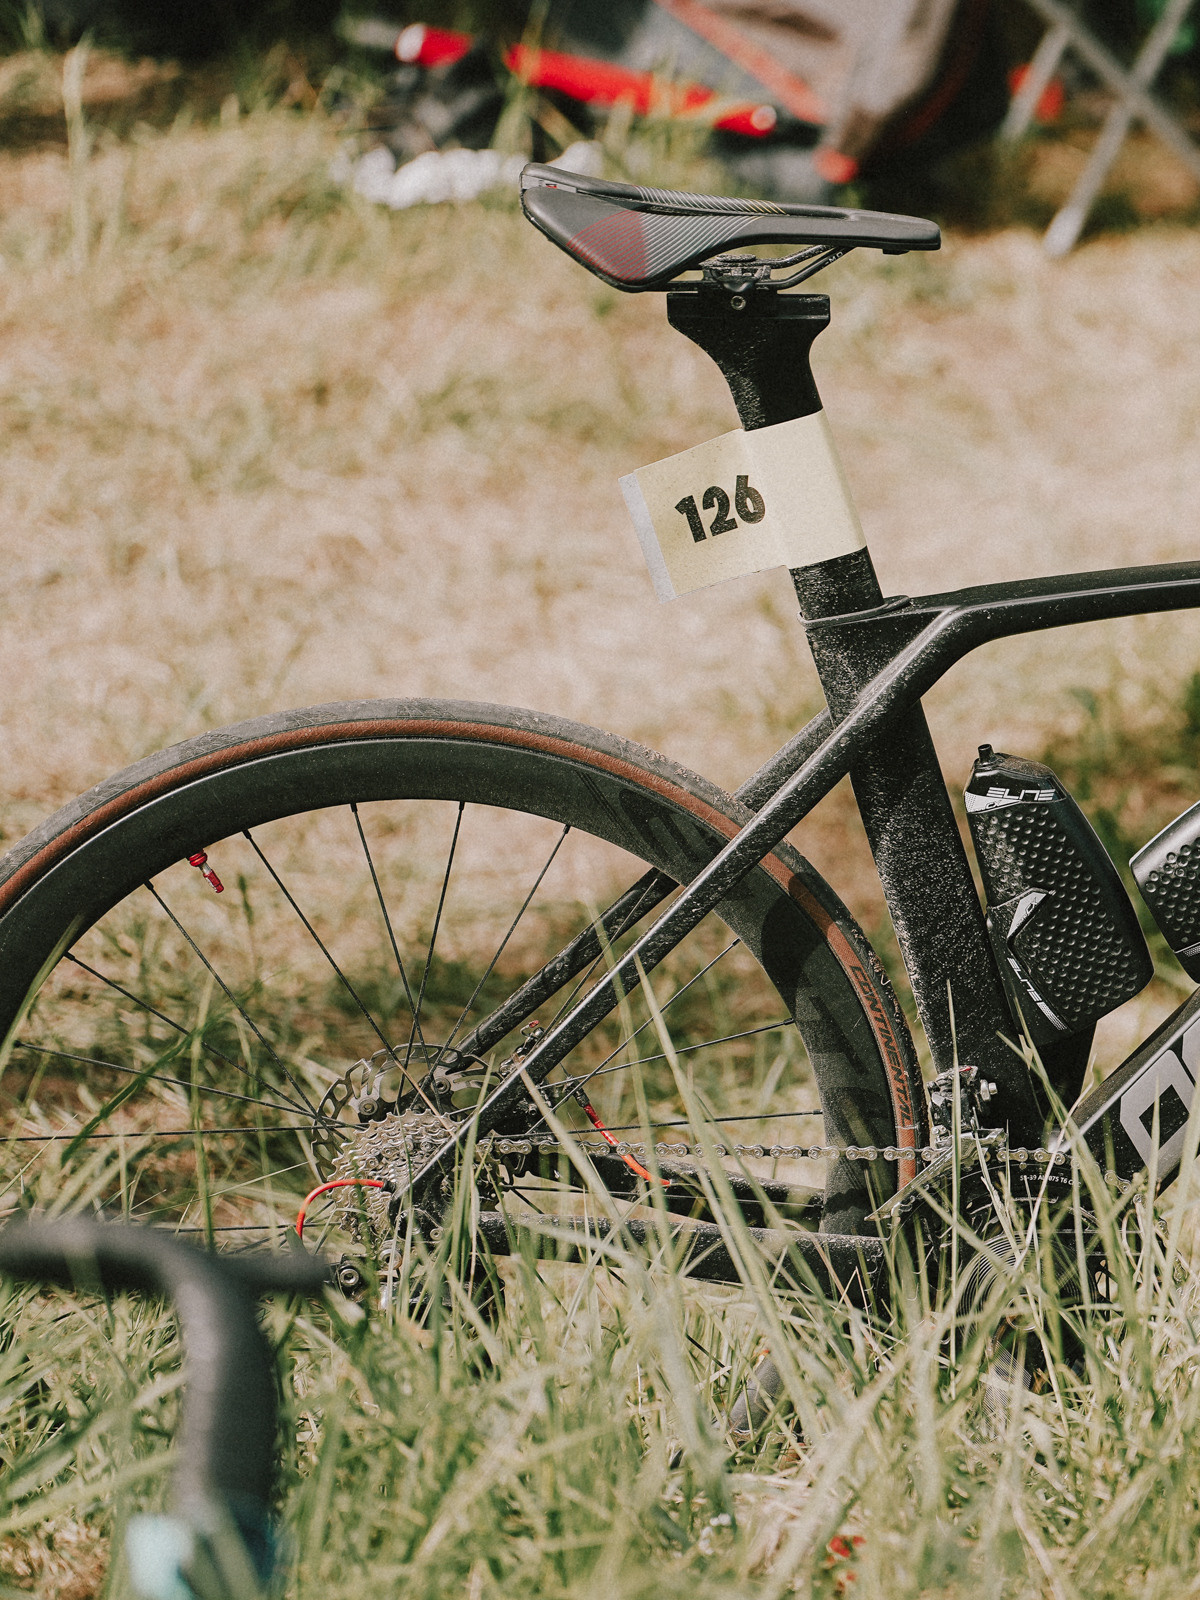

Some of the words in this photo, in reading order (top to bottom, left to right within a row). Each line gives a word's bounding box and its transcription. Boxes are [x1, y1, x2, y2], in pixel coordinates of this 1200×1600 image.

[674, 475, 766, 543] 126
[849, 964, 913, 1128] CONTINENTAL
[1019, 1174, 1038, 1182] 5-39
